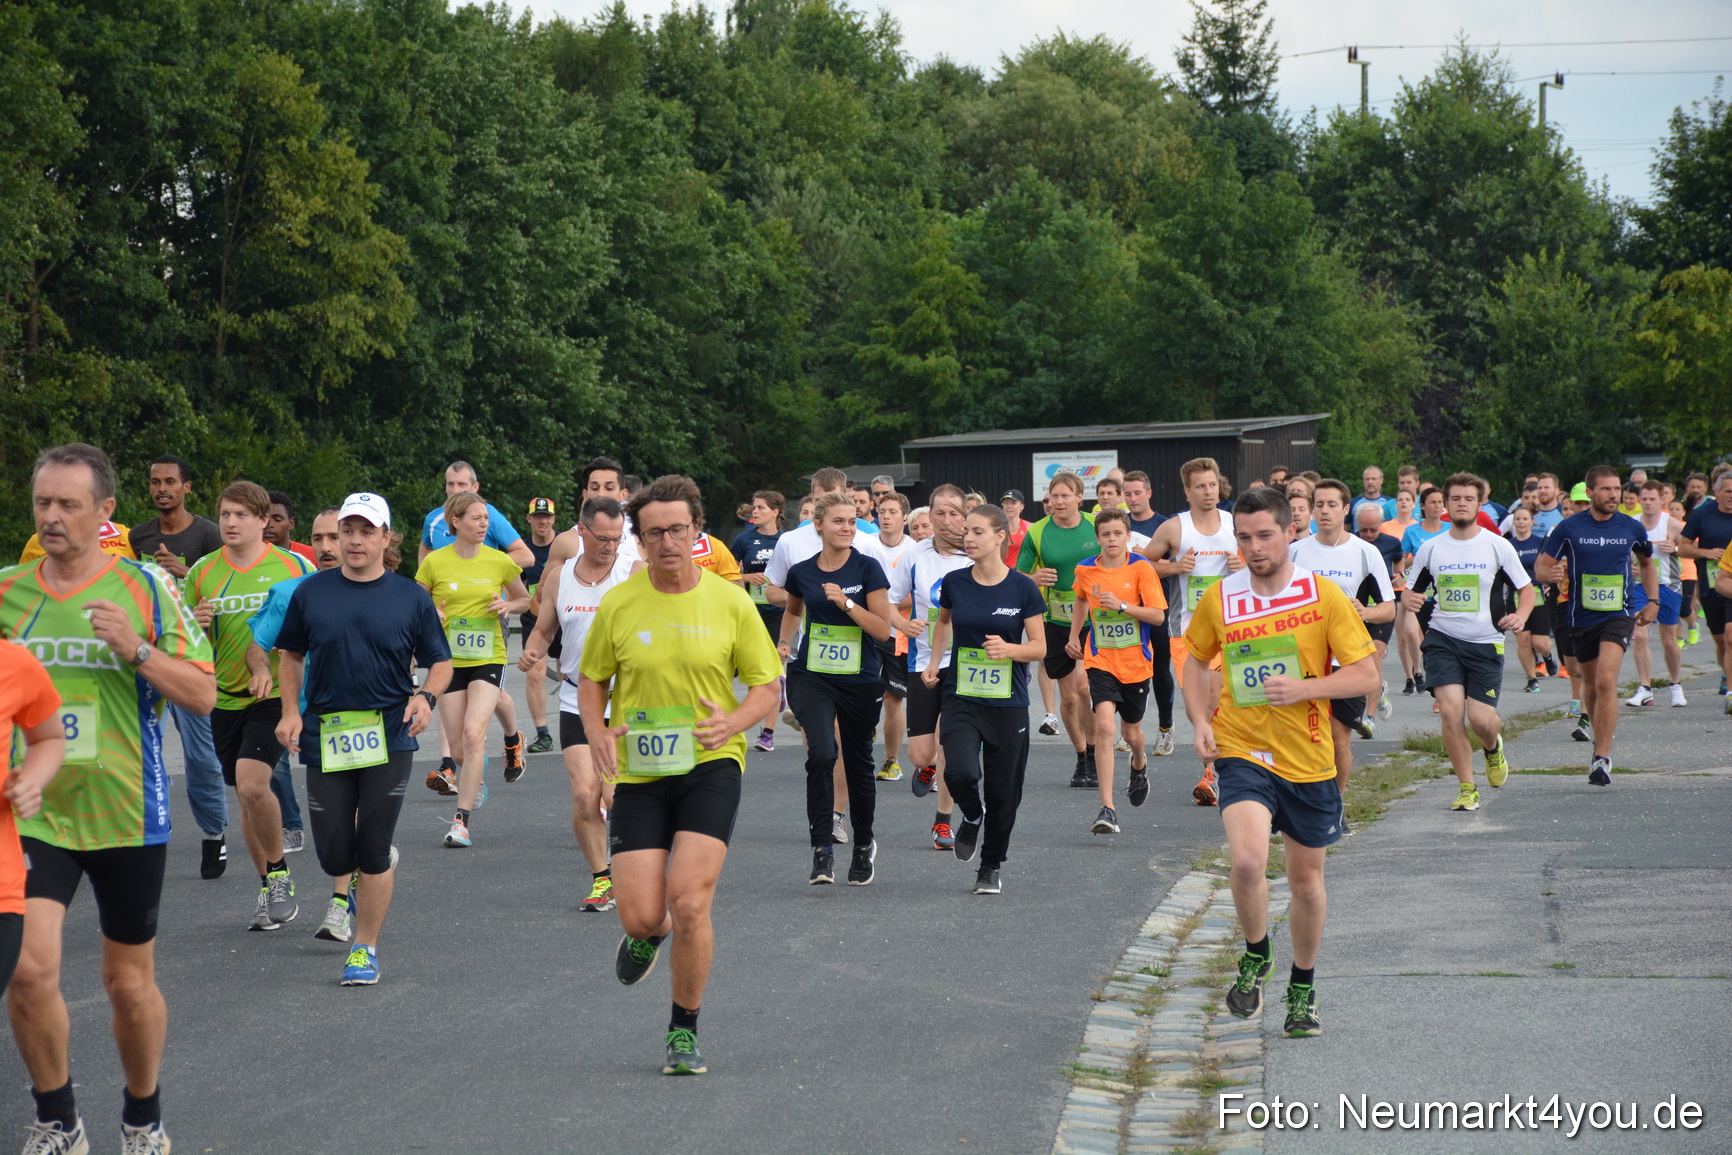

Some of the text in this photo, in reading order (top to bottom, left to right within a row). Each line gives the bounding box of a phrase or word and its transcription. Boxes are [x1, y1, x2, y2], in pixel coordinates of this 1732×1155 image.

[1579, 537, 1628, 545] EURO POLES
[1438, 563, 1487, 572] DELPHI
[1445, 589, 1471, 602] 286
[1589, 588, 1616, 601] 364
[1098, 622, 1135, 638] 1296
[1225, 609, 1324, 645] MAX BÖGL
[456, 632, 486, 648] 616
[818, 643, 850, 661] 750
[967, 666, 1001, 684] 715
[327, 730, 380, 755] 1306
[637, 733, 680, 757] 607
